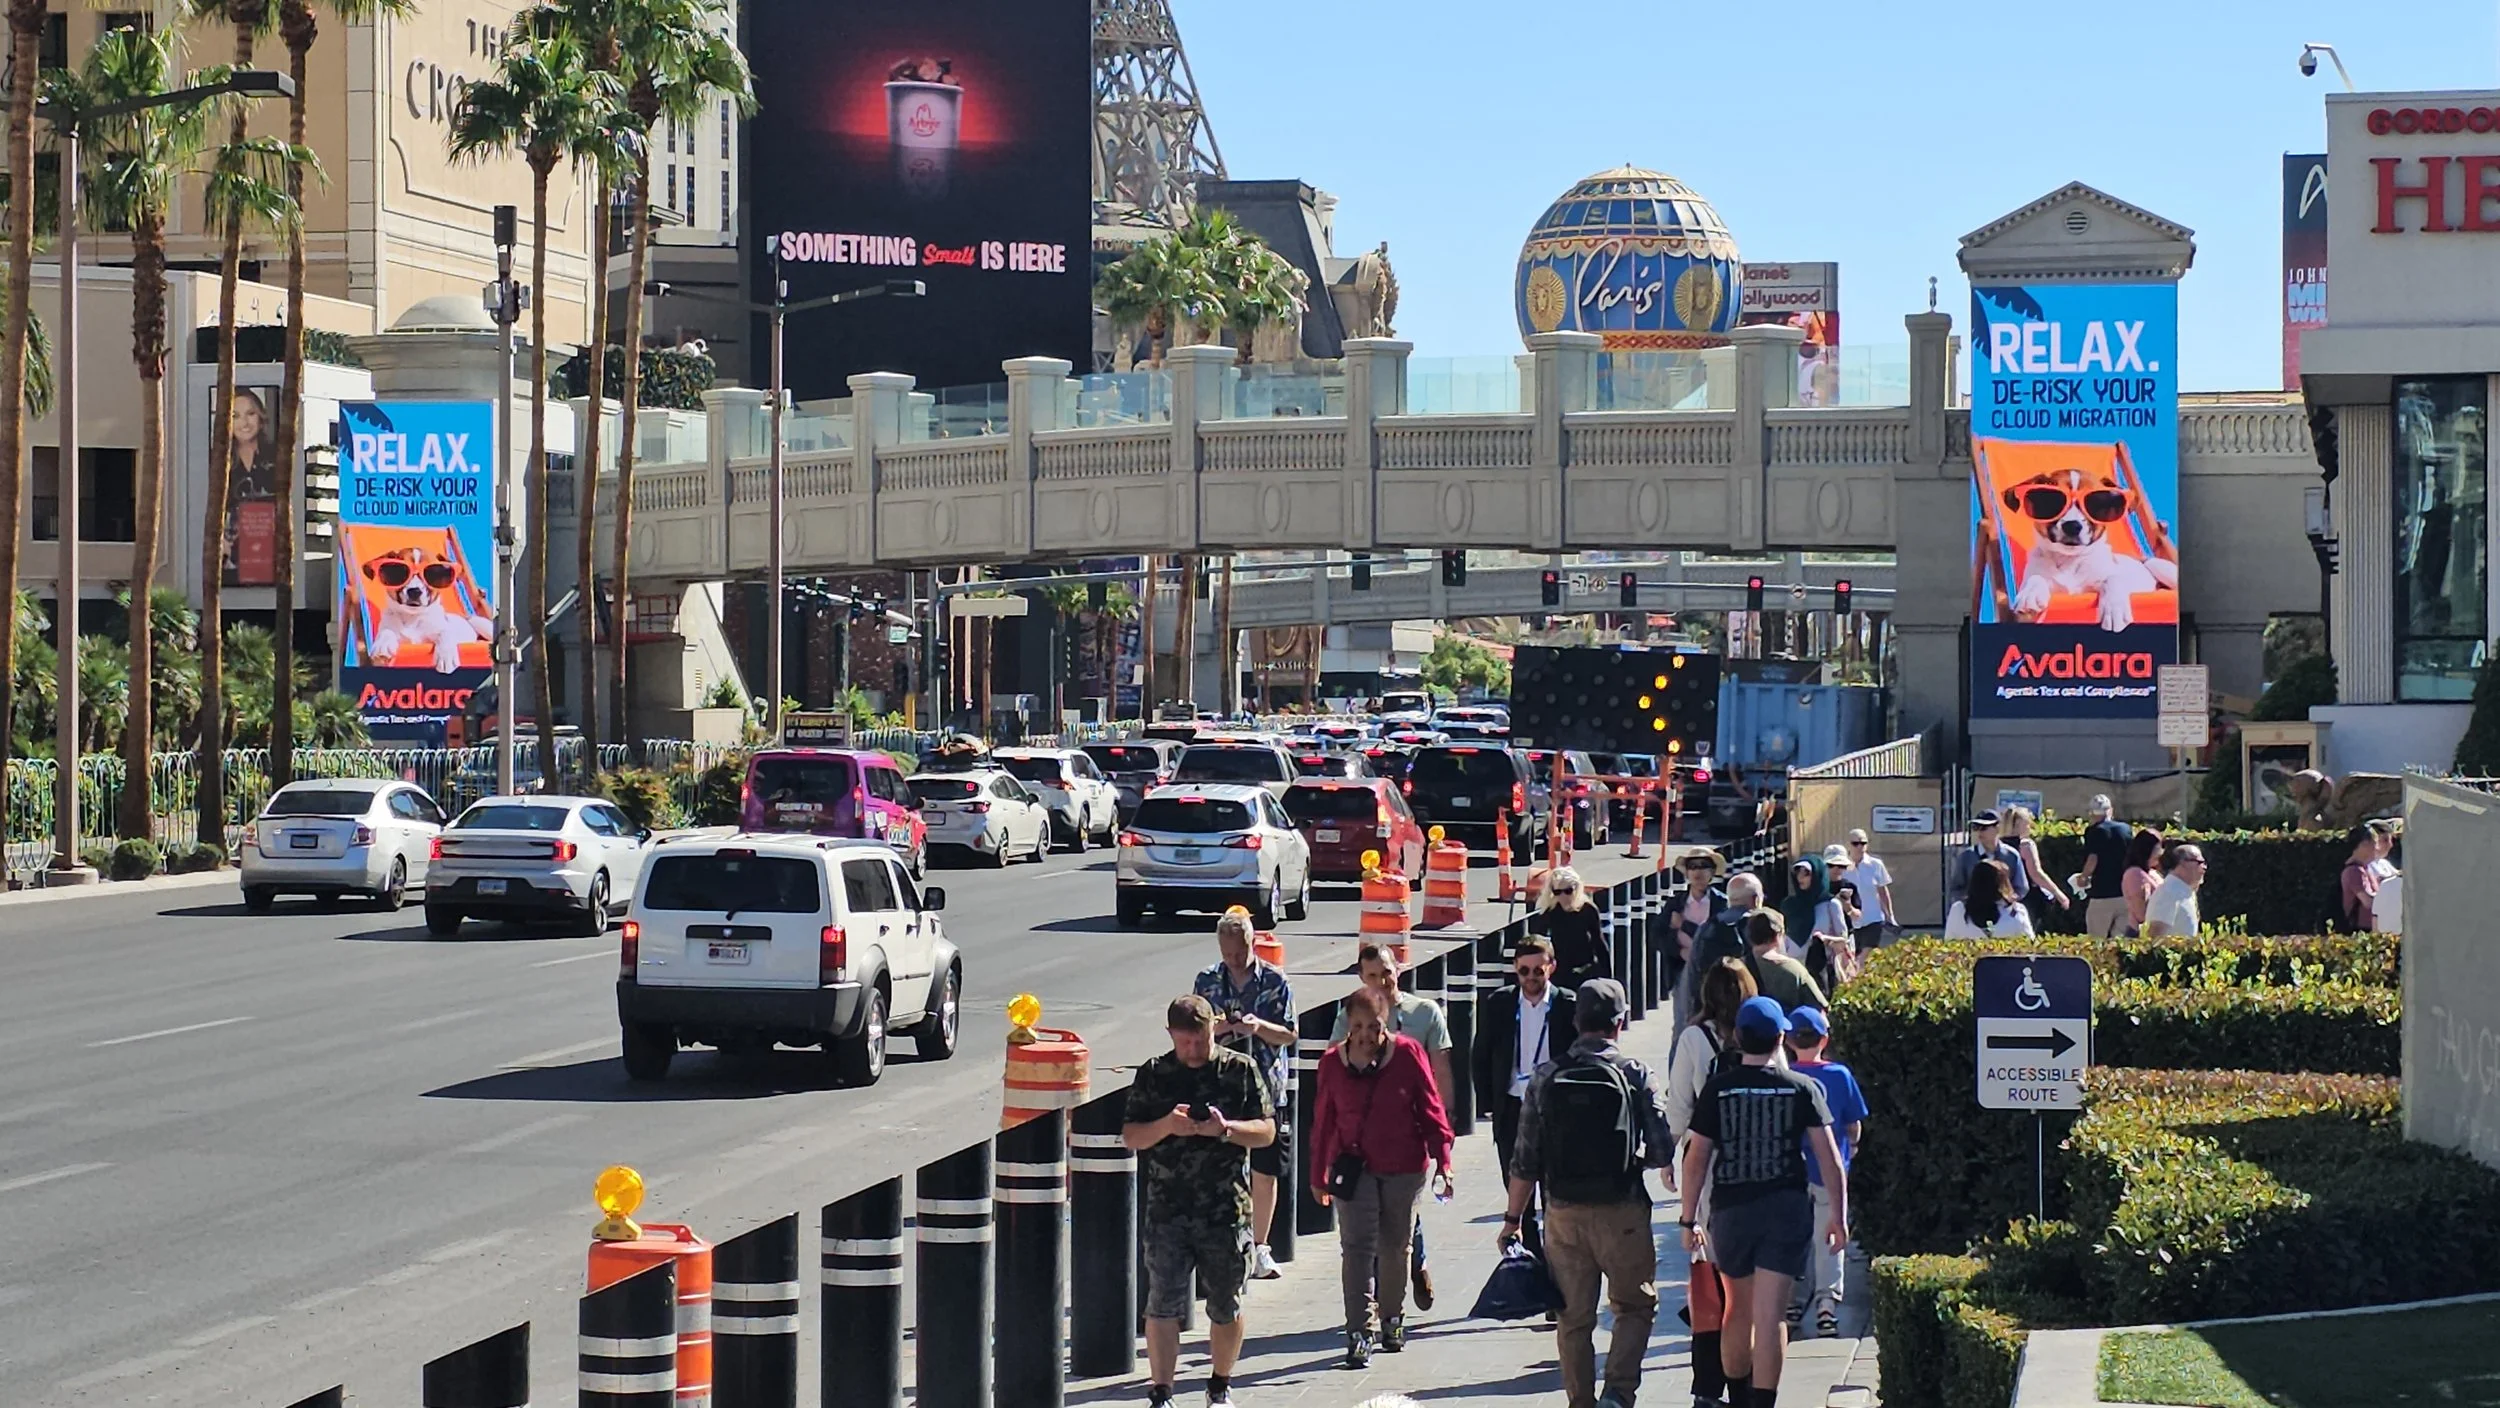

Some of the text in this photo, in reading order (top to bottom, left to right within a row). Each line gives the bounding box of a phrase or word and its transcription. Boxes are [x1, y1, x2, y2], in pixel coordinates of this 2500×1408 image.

[2367, 107, 2500, 136] GORDO
[2368, 156, 2500, 234] HE
[780, 231, 1066, 273] SOMETHING Small IS HERE
[1743, 264, 1790, 280] lanet
[1574, 238, 1662, 332] Paris
[1742, 289, 1821, 309] ollywood
[1990, 320, 2160, 374] RELAX.
[2093, 378, 2157, 404] YOUR
[1991, 408, 2157, 429] CLOUD MIGRATION
[352, 432, 480, 474] RELAX.
[430, 477, 478, 497] YOUR
[354, 500, 478, 516] CLOUD MIGRATION
[1997, 643, 2153, 678] Avalara
[2061, 685, 2084, 697] and
[1986, 1067, 2081, 1081] ACCESSIBLE
[2008, 1088, 2060, 1102] ROUTE
